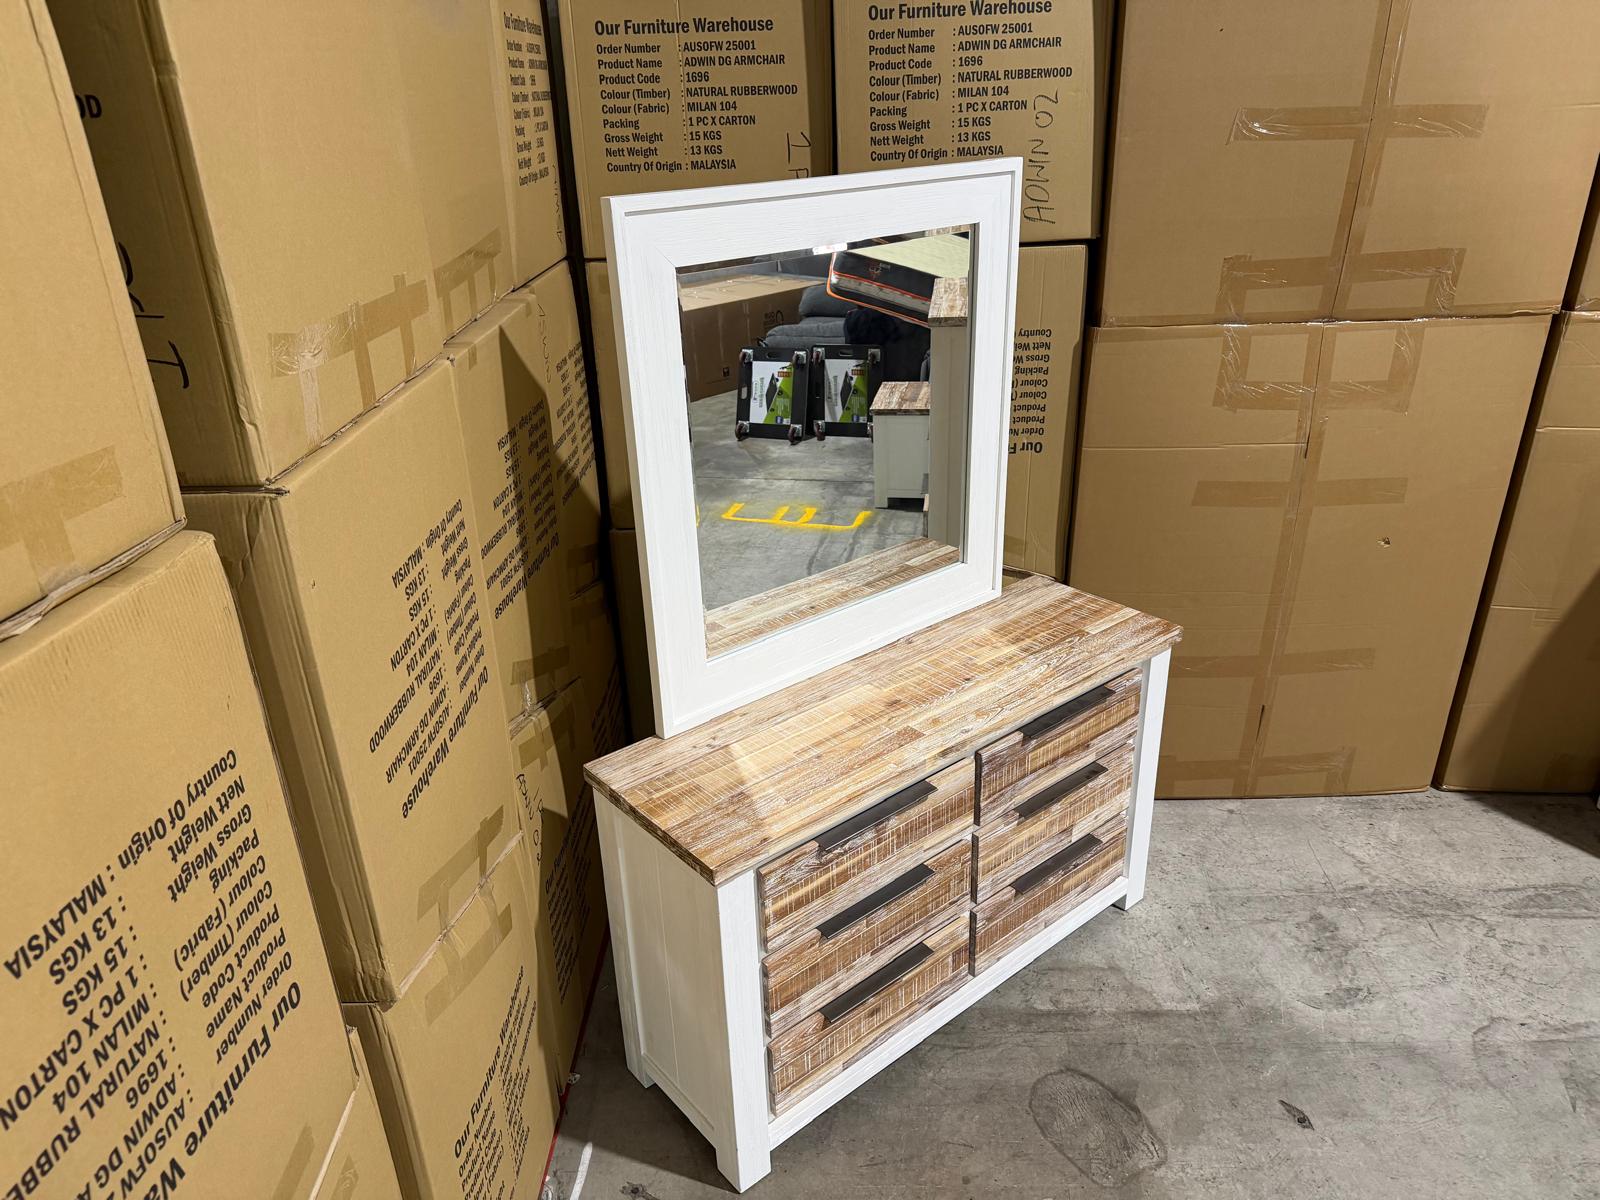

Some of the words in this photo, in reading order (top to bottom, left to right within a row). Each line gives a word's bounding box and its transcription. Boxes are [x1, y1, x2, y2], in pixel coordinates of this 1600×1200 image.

[594, 20, 621, 36] Our
[624, 16, 690, 35] Furniture
[692, 16, 774, 33] Warehouse
[868, 5, 895, 21] Our
[898, 2, 966, 20] Furniture
[970, 0, 1052, 16] Warehouse
[596, 44, 623, 55] Order
[624, 42, 661, 54] Number
[684, 40, 724, 52] AUSOFW
[725, 40, 756, 51] 25001
[868, 28, 896, 40] Order
[897, 27, 935, 39] Number
[957, 24, 1000, 36] AUSOFW
[1001, 22, 1033, 34] 25001
[868, 44, 906, 56] Product
[908, 43, 935, 54] Name
[957, 39, 990, 52] ADWIN
[993, 39, 1007, 50] DG
[1008, 36, 1062, 49] ARMCHAIR
[597, 58, 634, 70] Product
[635, 58, 663, 69] Name
[684, 55, 716, 67] ADWIN
[718, 55, 732, 66] DG
[733, 54, 786, 66] ARMCHAIR
[599, 73, 636, 85] Product
[637, 72, 661, 84] Code
[686, 71, 710, 83] 1696
[869, 59, 906, 71] Product
[908, 58, 932, 69] Code
[958, 55, 983, 67] 1696
[869, 75, 900, 87] Colour
[902, 73, 942, 88] (Timber)
[958, 70, 1002, 83] NATURAL
[1003, 66, 1072, 80] RUBBERWOOD
[600, 89, 631, 100] Colour
[632, 88, 671, 101] (Timber)
[686, 86, 729, 98] NATURAL
[730, 84, 798, 97] RUBBERWOOD
[601, 104, 632, 114] Colour
[633, 102, 670, 116] (Fabric)
[687, 100, 717, 112] MILAN
[719, 100, 738, 111] 104
[869, 91, 900, 102] Colour
[902, 88, 939, 103] (Fabric)
[958, 86, 988, 98] MILAN
[991, 85, 1010, 97] 104
[870, 105, 908, 118] Packing
[958, 102, 964, 113] 1
[966, 102, 979, 112] PC
[980, 101, 987, 112] X
[989, 99, 1028, 112] CARTON
[603, 118, 640, 130] Packing
[688, 116, 694, 127] 1
[696, 116, 709, 126] PC
[710, 115, 717, 126] X
[718, 115, 756, 126] CARTON
[604, 133, 631, 143] Gross
[631, 132, 664, 145] Weight
[689, 130, 701, 141] 15
[703, 130, 722, 141] KGS
[870, 121, 897, 132] Gross
[898, 119, 931, 132] Weight
[957, 117, 970, 128] 15
[972, 116, 991, 127] KGS
[870, 135, 890, 147] Nett
[891, 134, 924, 147] Weight
[957, 132, 969, 143] 13
[971, 131, 991, 142] KGS
[605, 147, 626, 158] Nett
[626, 146, 658, 159] Weight
[690, 145, 702, 156] 13
[704, 144, 723, 155] KGS
[606, 162, 642, 174] Country
[643, 160, 654, 172] Of
[655, 160, 682, 173] Origin
[690, 158, 737, 170] MALAYSIA
[870, 150, 906, 163] Country
[908, 148, 919, 160] Of
[920, 148, 948, 161] Origin
[957, 145, 1004, 157] MALAYSIA
[1018, 328, 1052, 338] Country
[1032, 342, 1051, 350] Nett
[1014, 366, 1049, 375] Packing
[1026, 354, 1050, 362] Gross
[1019, 391, 1047, 399] Colour
[1020, 379, 1048, 387] Colour
[1013, 416, 1045, 424] Product
[1014, 404, 1046, 412] Product
[1020, 441, 1042, 453] Our
[1021, 427, 1044, 436] Order
[391, 545, 423, 589] MALAYSIA
[418, 627, 437, 661] MILAN
[406, 652, 418, 677] 104
[414, 647, 441, 689] NATURAL
[428, 667, 443, 695] 1696
[477, 666, 488, 692] Our
[369, 681, 416, 753] RUBBERWOOD
[428, 685, 446, 721] ADWIN
[448, 684, 478, 743] Furniture
[419, 712, 429, 734] DG
[427, 703, 450, 748] AUSOFW
[385, 725, 419, 784] ARMCHAIR
[408, 738, 428, 776] 25001
[186, 749, 237, 807] Country
[216, 775, 245, 815] Nett
[402, 737, 450, 819] Warehouse
[168, 799, 186, 830] Of
[216, 803, 252, 847] Gross
[118, 817, 167, 869] Origin
[167, 805, 219, 864] Weight
[167, 841, 218, 903] Weight
[209, 828, 260, 894] Packing
[228, 855, 266, 907] Colour
[92, 906, 117, 942] 13
[236, 880, 272, 933] Colour
[3, 874, 107, 979] MALAYSIA
[174, 898, 227, 972] (Fabric)
[234, 903, 280, 969] Product
[49, 932, 92, 985] KGS
[104, 936, 128, 973] 15
[180, 923, 234, 1002] (Timber)
[241, 926, 286, 993] Product
[62, 962, 104, 1015] KGS
[125, 965, 138, 988] 1
[202, 963, 235, 1008] Code
[262, 951, 292, 999] Order
[99, 980, 126, 1018] PC
[206, 986, 243, 1038] Name
[272, 982, 301, 1032] Our
[82, 1008, 100, 1037] X
[92, 993, 150, 1068] MILAN
[216, 993, 262, 1064] Number
[80, 1020, 160, 1119] NATURAL
[126, 1049, 168, 1109] 1696
[454, 1120, 470, 1158] Our
[470, 1046, 500, 1124] Furniture
[500, 965, 524, 1046] Warehouse
[0, 1029, 82, 1131] CARTON
[53, 1061, 91, 1114] 104
[184, 1024, 271, 1156] Furniture
[123, 1072, 176, 1154] ADWIN
[120, 1098, 185, 1200] AUSOFW
[459, 1142, 474, 1177] Order
[94, 1146, 123, 1189] DG
